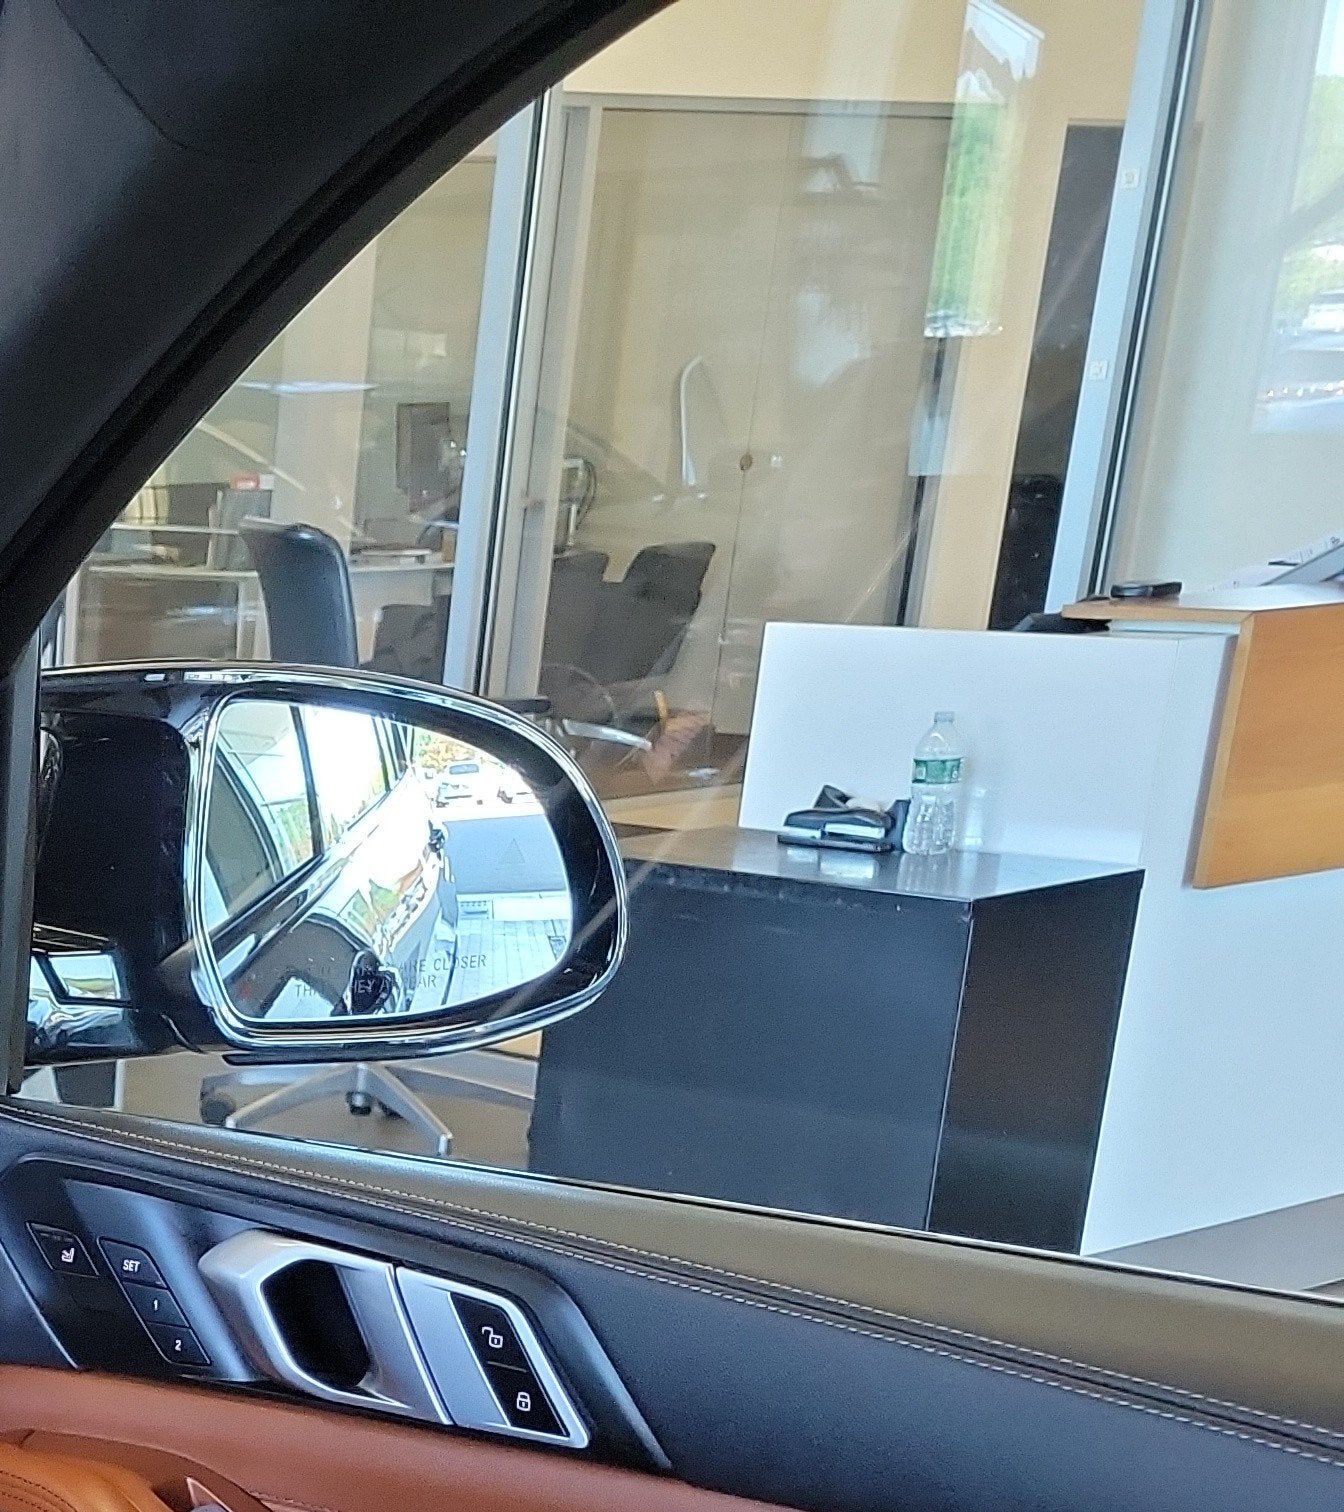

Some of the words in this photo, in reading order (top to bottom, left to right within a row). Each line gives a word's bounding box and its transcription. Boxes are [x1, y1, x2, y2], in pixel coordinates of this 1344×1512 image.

[433, 954, 487, 972] CLOSER
[122, 1259, 141, 1273] SET
[153, 1299, 159, 1312] 1
[174, 1339, 182, 1352] 2
